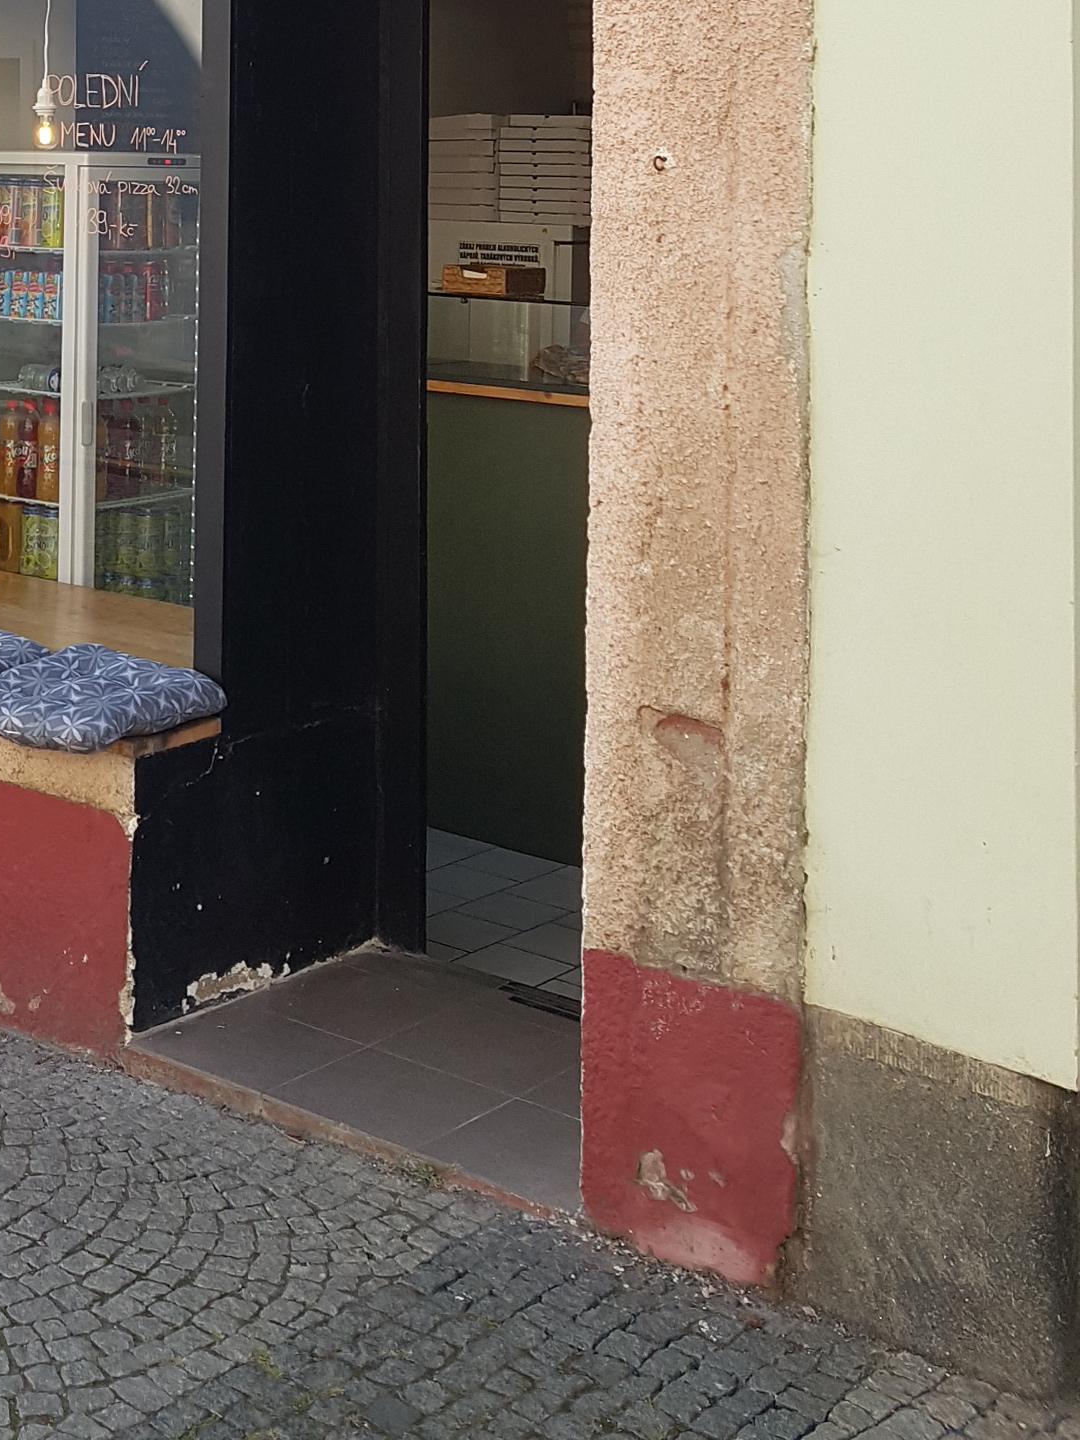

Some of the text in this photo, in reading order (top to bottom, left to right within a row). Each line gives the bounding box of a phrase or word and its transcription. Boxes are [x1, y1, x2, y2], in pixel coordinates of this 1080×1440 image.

[47, 60, 149, 109] POLEDNÍ
[60, 122, 116, 148] MENU
[119, 180, 160, 207] pizza
